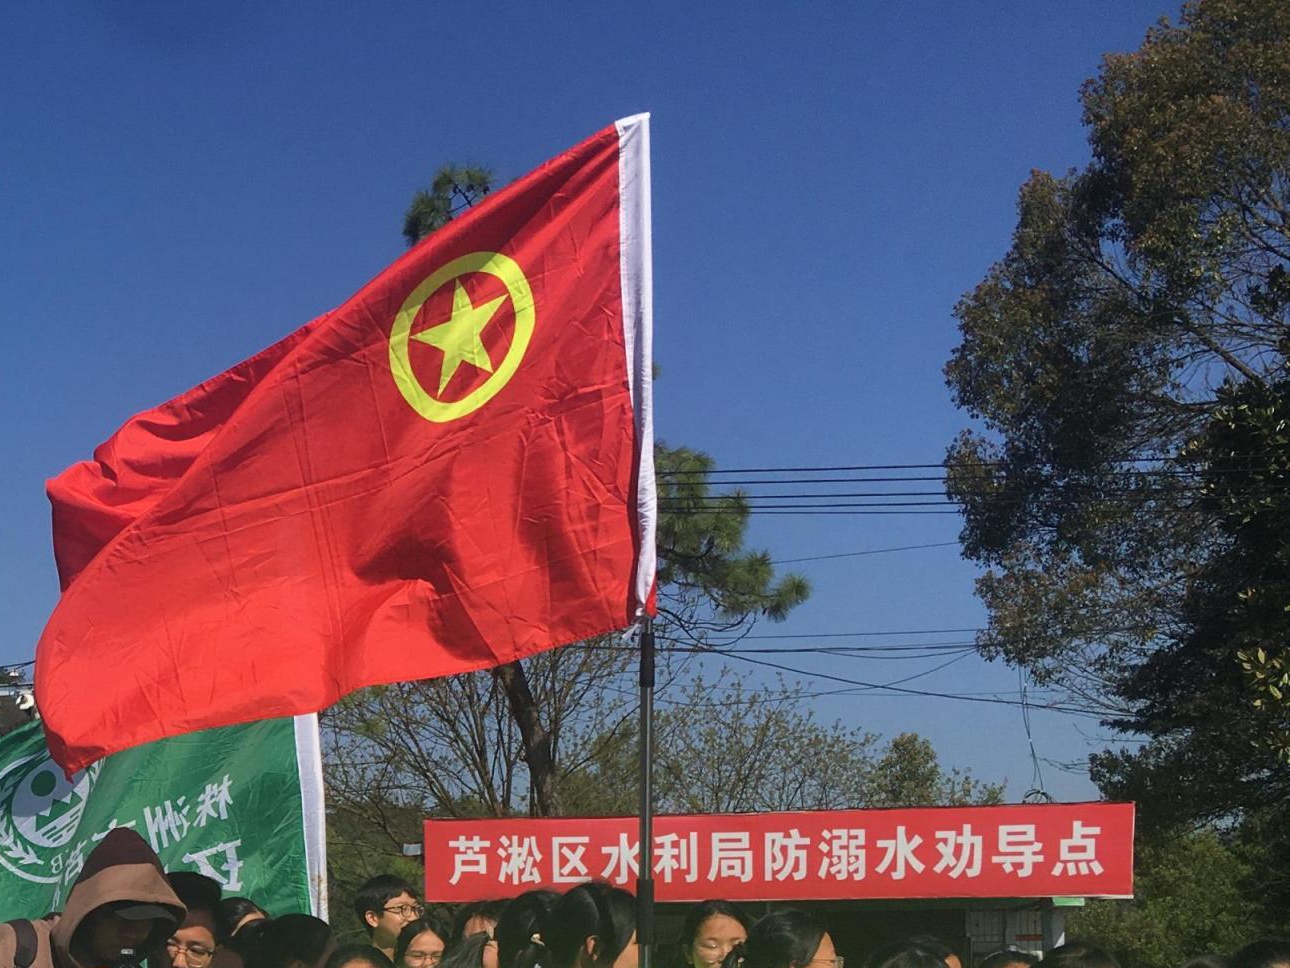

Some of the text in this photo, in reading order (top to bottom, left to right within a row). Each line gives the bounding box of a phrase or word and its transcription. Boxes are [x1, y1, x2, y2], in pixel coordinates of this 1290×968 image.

[448, 820, 1104, 886] 芦淞区水利局防溺水劝导点
